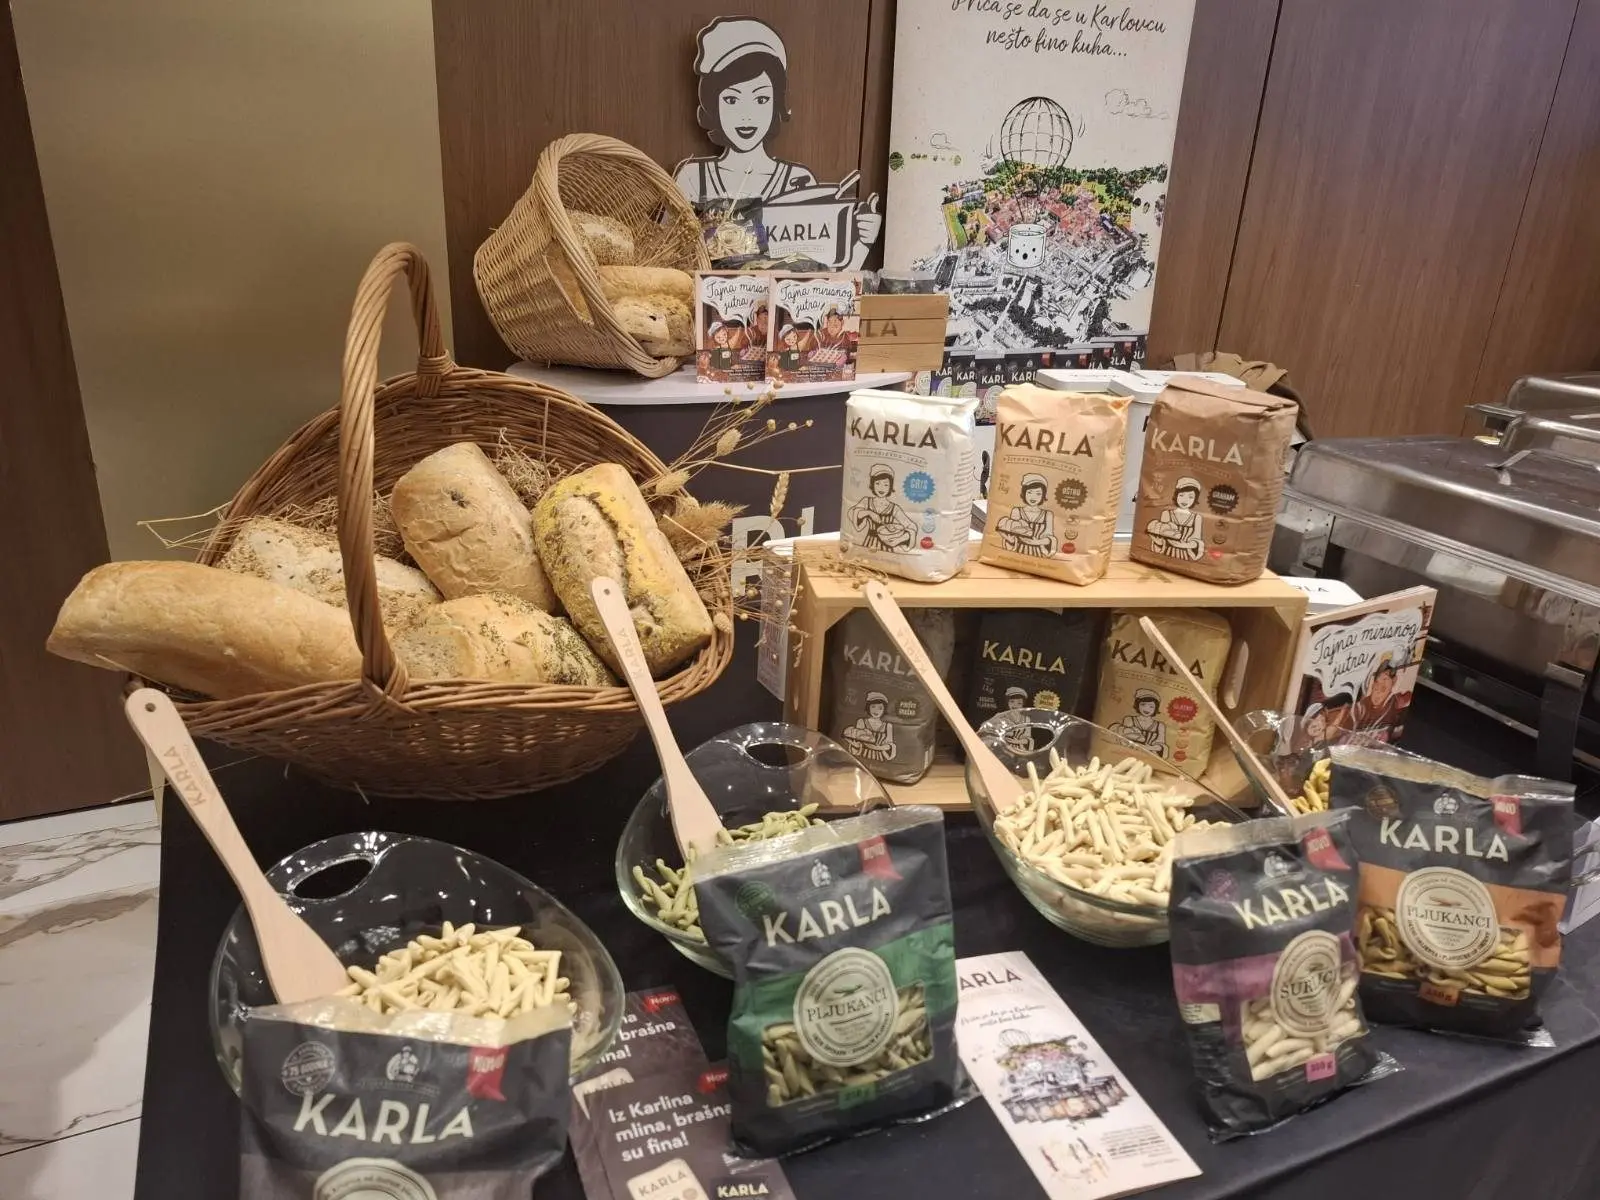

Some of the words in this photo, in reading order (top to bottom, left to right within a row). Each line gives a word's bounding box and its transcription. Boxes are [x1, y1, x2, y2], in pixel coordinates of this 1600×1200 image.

[1003, 2, 1023, 20] se
[1028, 0, 1051, 19] da
[1052, 8, 1071, 26] se
[1076, 12, 1088, 24] u
[1090, 4, 1166, 33] Karlovcu
[986, 26, 1032, 50] nešto
[1035, 27, 1069, 53] fino
[766, 223, 831, 242] KARLA
[706, 281, 737, 299] Tajna
[740, 283, 769, 294] mirisn
[780, 284, 810, 302] Tajna
[813, 286, 853, 301] mirisnog
[724, 295, 748, 315] jutra
[795, 299, 820, 317] jutra
[862, 316, 898, 337] LA
[935, 366, 952, 377] KAR
[957, 371, 976, 381] KAR
[981, 374, 1006, 385] KARL
[851, 416, 938, 449] KARLA
[1000, 423, 1093, 458] KARLA
[1151, 428, 1243, 466] KARLA
[1312, 632, 1357, 665] Tajna
[1362, 621, 1418, 643] mirisnog
[982, 639, 1067, 675] KARLA
[1111, 639, 1204, 680] KARA
[1330, 651, 1370, 688] jutra
[164, 746, 206, 808] KARLA
[1380, 816, 1509, 863] KARLA
[1231, 876, 1349, 930] KARLA
[762, 886, 892, 948] KARLA
[1407, 905, 1491, 929] PLJUKANCI
[960, 968, 1022, 991] ARLA
[807, 987, 887, 1022] PLJUKANCI
[618, 1021, 676, 1041] brašna
[597, 1044, 632, 1064] ina!
[705, 1072, 729, 1083] Nov
[293, 1091, 474, 1145] KARLA
[608, 1108, 627, 1124] Iz
[628, 1093, 694, 1118] Karlina
[615, 1118, 672, 1143] mlina,
[621, 1146, 643, 1163] su
[647, 1131, 690, 1156] fina!
[638, 1170, 687, 1197] KARLA
[717, 1181, 769, 1198] KARLA
